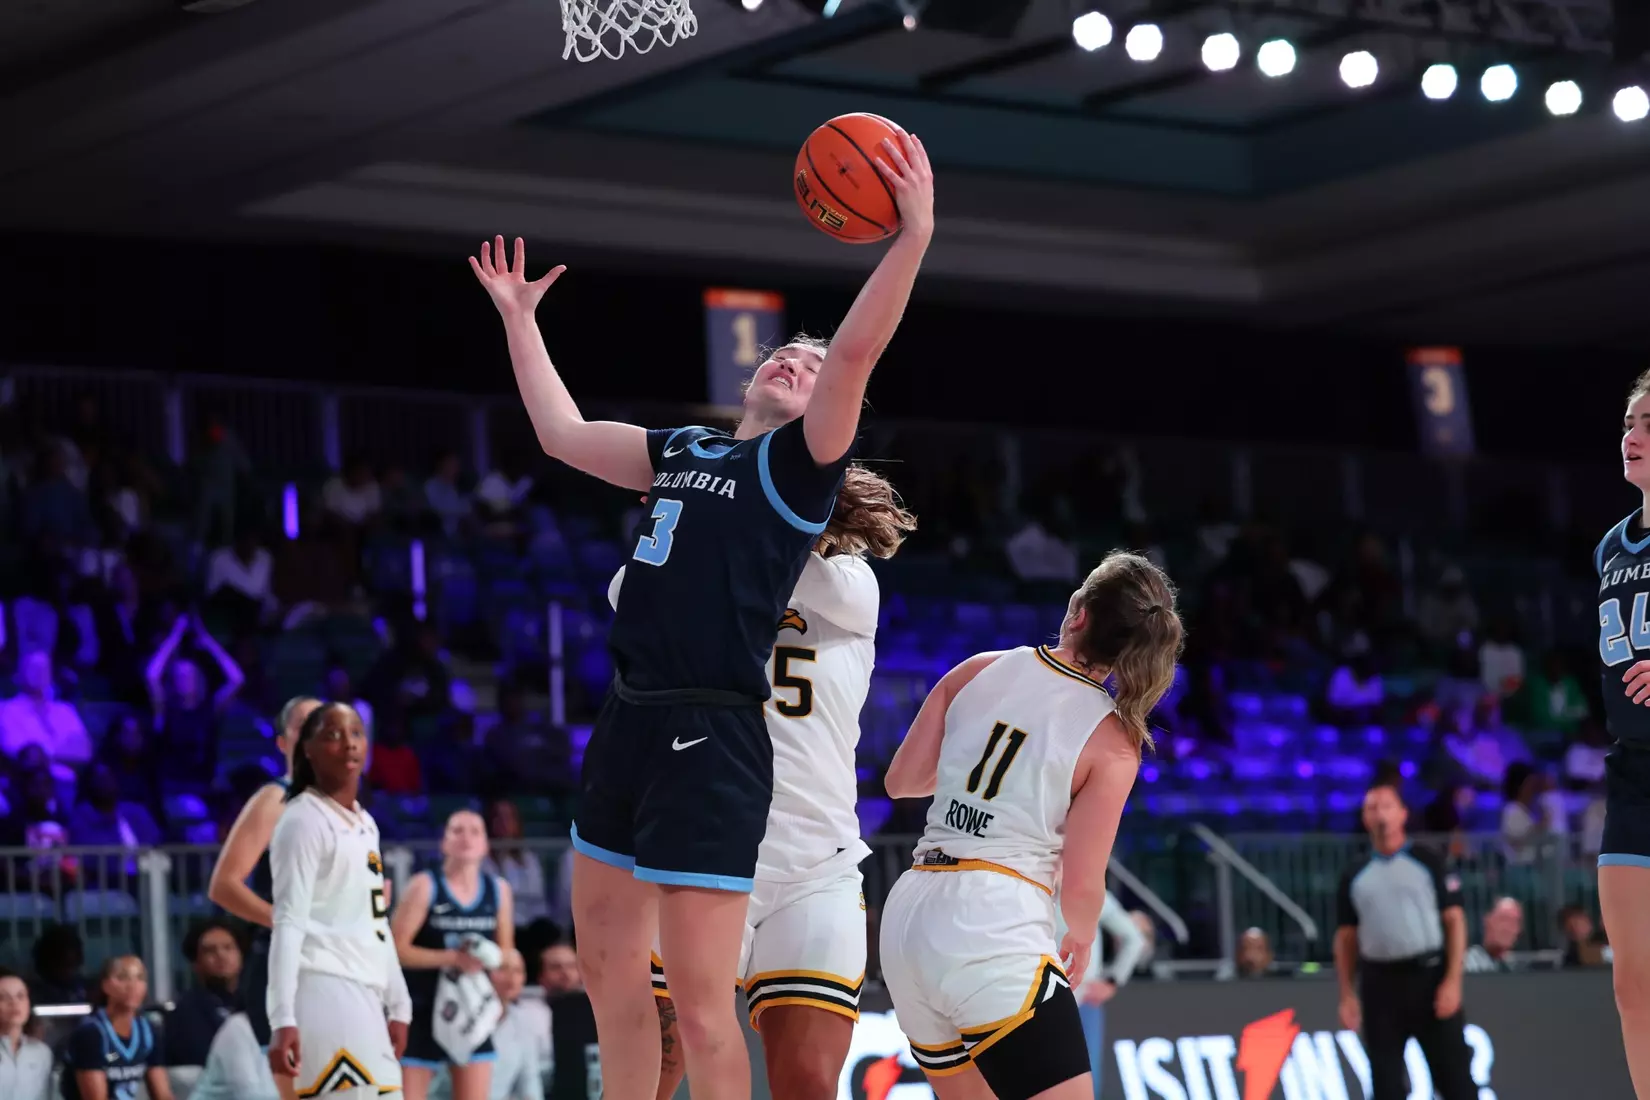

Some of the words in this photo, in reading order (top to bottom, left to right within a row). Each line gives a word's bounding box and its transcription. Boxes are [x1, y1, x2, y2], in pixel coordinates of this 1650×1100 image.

[731, 312, 758, 366] 1
[652, 470, 737, 499] OLUMBIA
[633, 498, 683, 566] 3
[965, 719, 1028, 802] 11
[945, 798, 995, 838] ROWE
